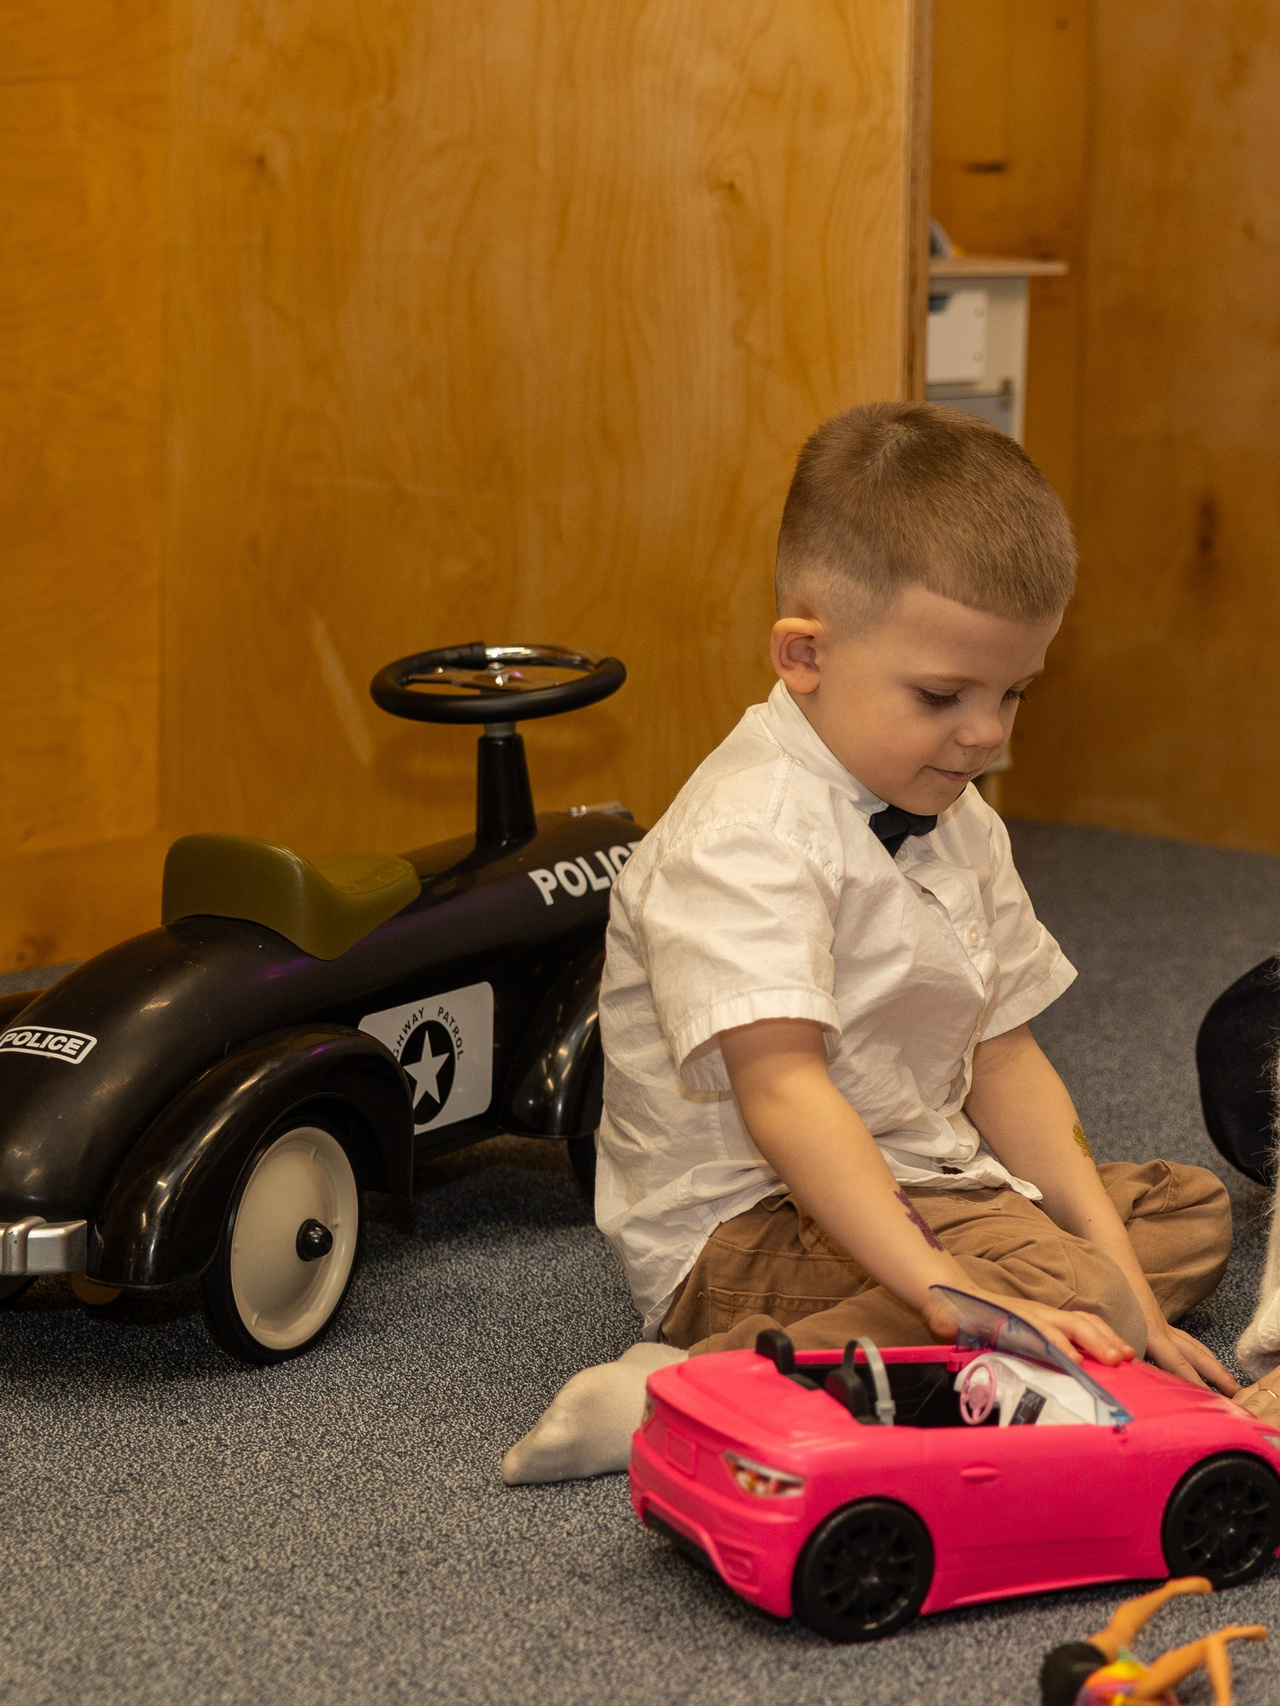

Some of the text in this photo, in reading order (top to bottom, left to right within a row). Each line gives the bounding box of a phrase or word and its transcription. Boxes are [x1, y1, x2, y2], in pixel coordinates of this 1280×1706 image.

[528, 841, 642, 906] POLIC
[0, 1031, 85, 1056] POLICE
[392, 1006, 464, 1060] GHWAY PATROL
